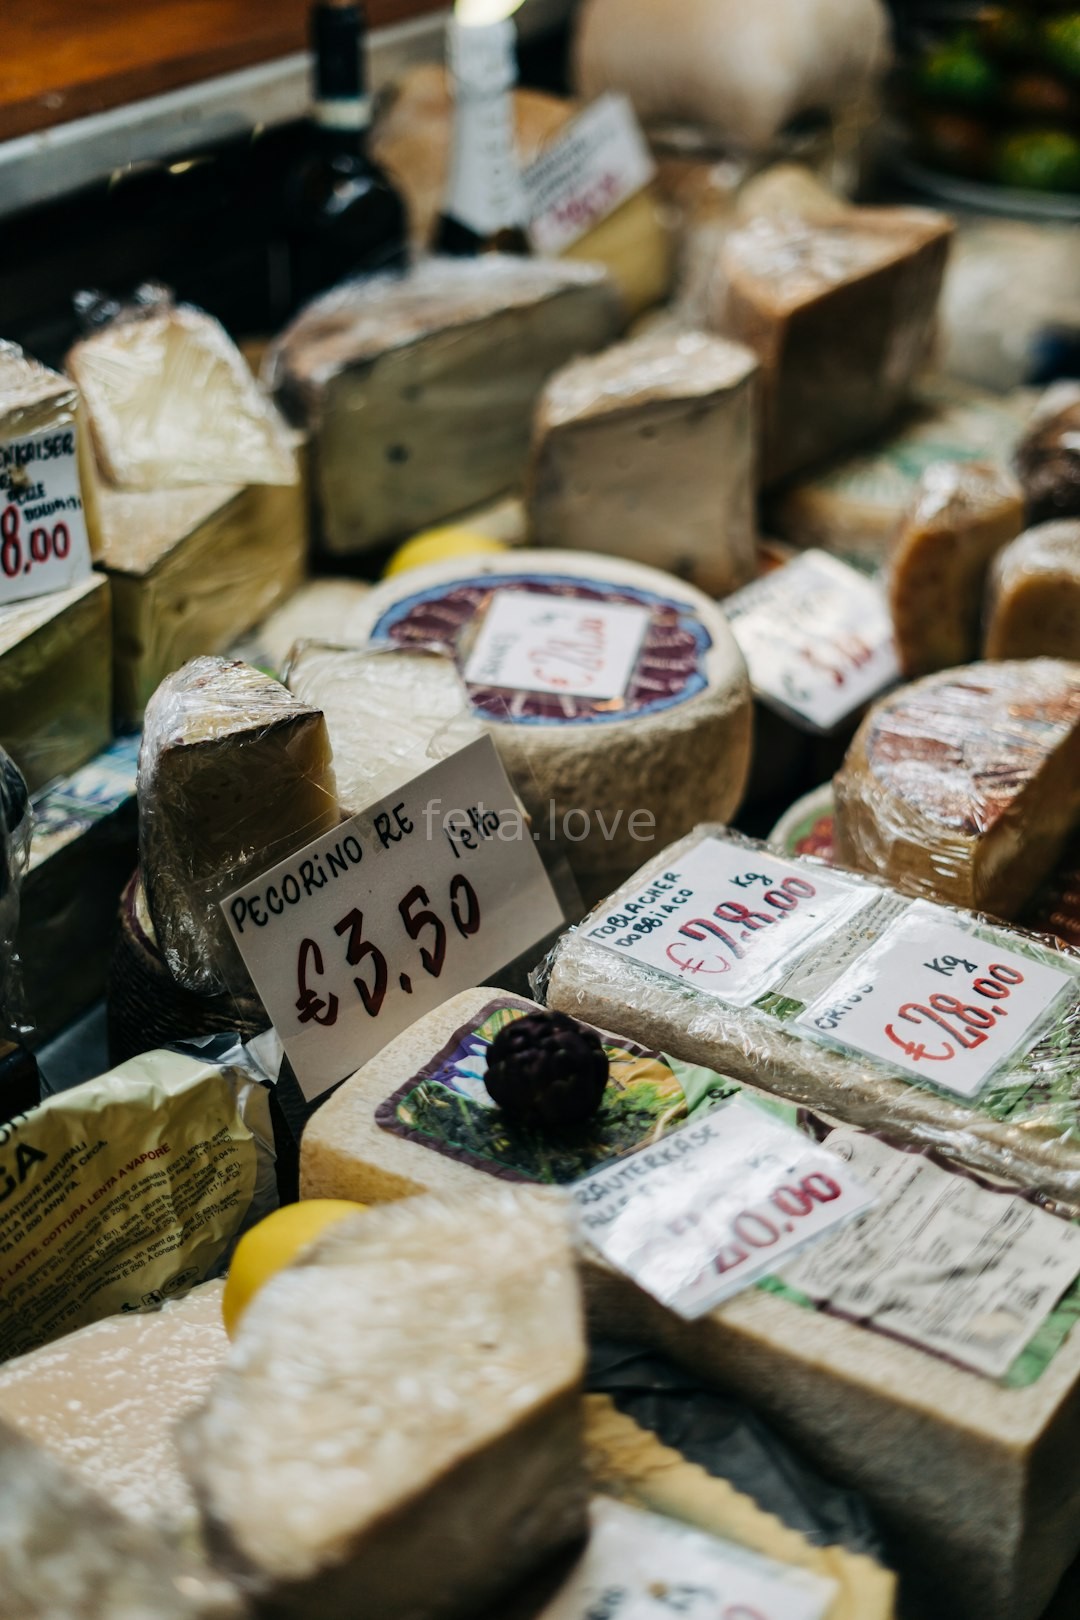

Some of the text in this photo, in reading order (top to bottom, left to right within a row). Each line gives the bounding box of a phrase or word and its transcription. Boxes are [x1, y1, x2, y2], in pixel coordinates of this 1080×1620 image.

[230, 802, 414, 933] PECORINO RE
[729, 871, 774, 888] Kg
[587, 871, 682, 940] TOBLACHER
[613, 888, 694, 947] DOBBIACO
[923, 954, 978, 977] Kg
[0, 1141, 88, 1226] MATICHE NATURALI
[42, 1203, 88, 1248] COTTURA
[87, 1176, 118, 1206] LENTA
[119, 1167, 128, 1179] A
[126, 1142, 172, 1171] VAPORE
[573, 1123, 720, 1206] RÄUTERKÄSE
[44, 1192, 66, 1217] ANNI
